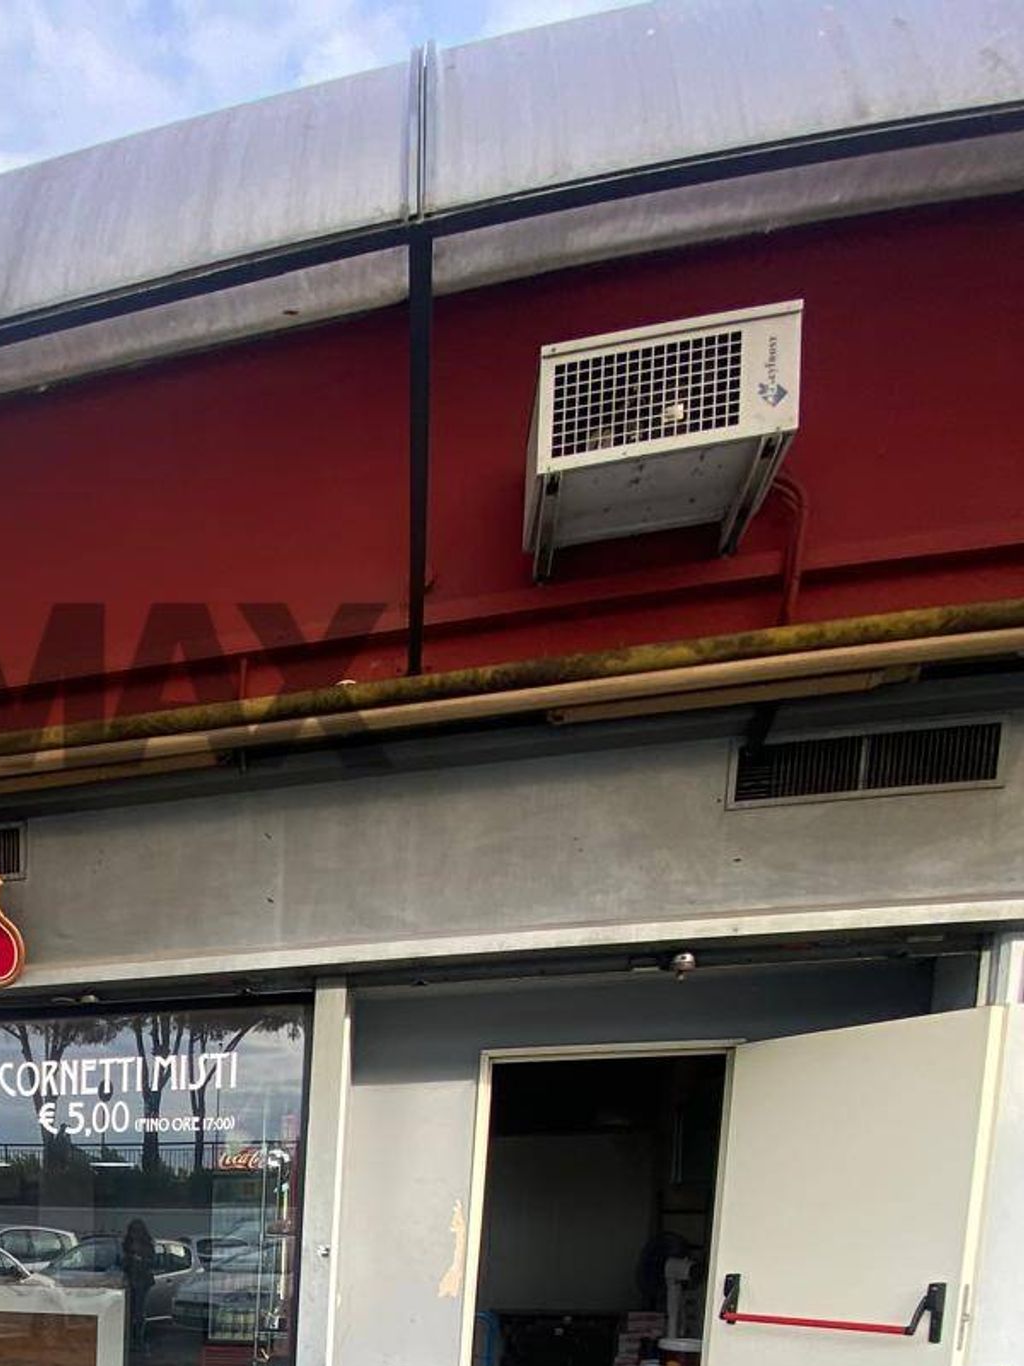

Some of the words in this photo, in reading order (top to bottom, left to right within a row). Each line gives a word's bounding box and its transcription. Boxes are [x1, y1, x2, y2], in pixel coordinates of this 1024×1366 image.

[152, 1051, 239, 1092] MISTI
[38, 1102, 59, 1136] €
[64, 1100, 129, 1138] 5,00
[171, 1116, 200, 1132] ORE
[202, 1114, 236, 1132] 17:00)
